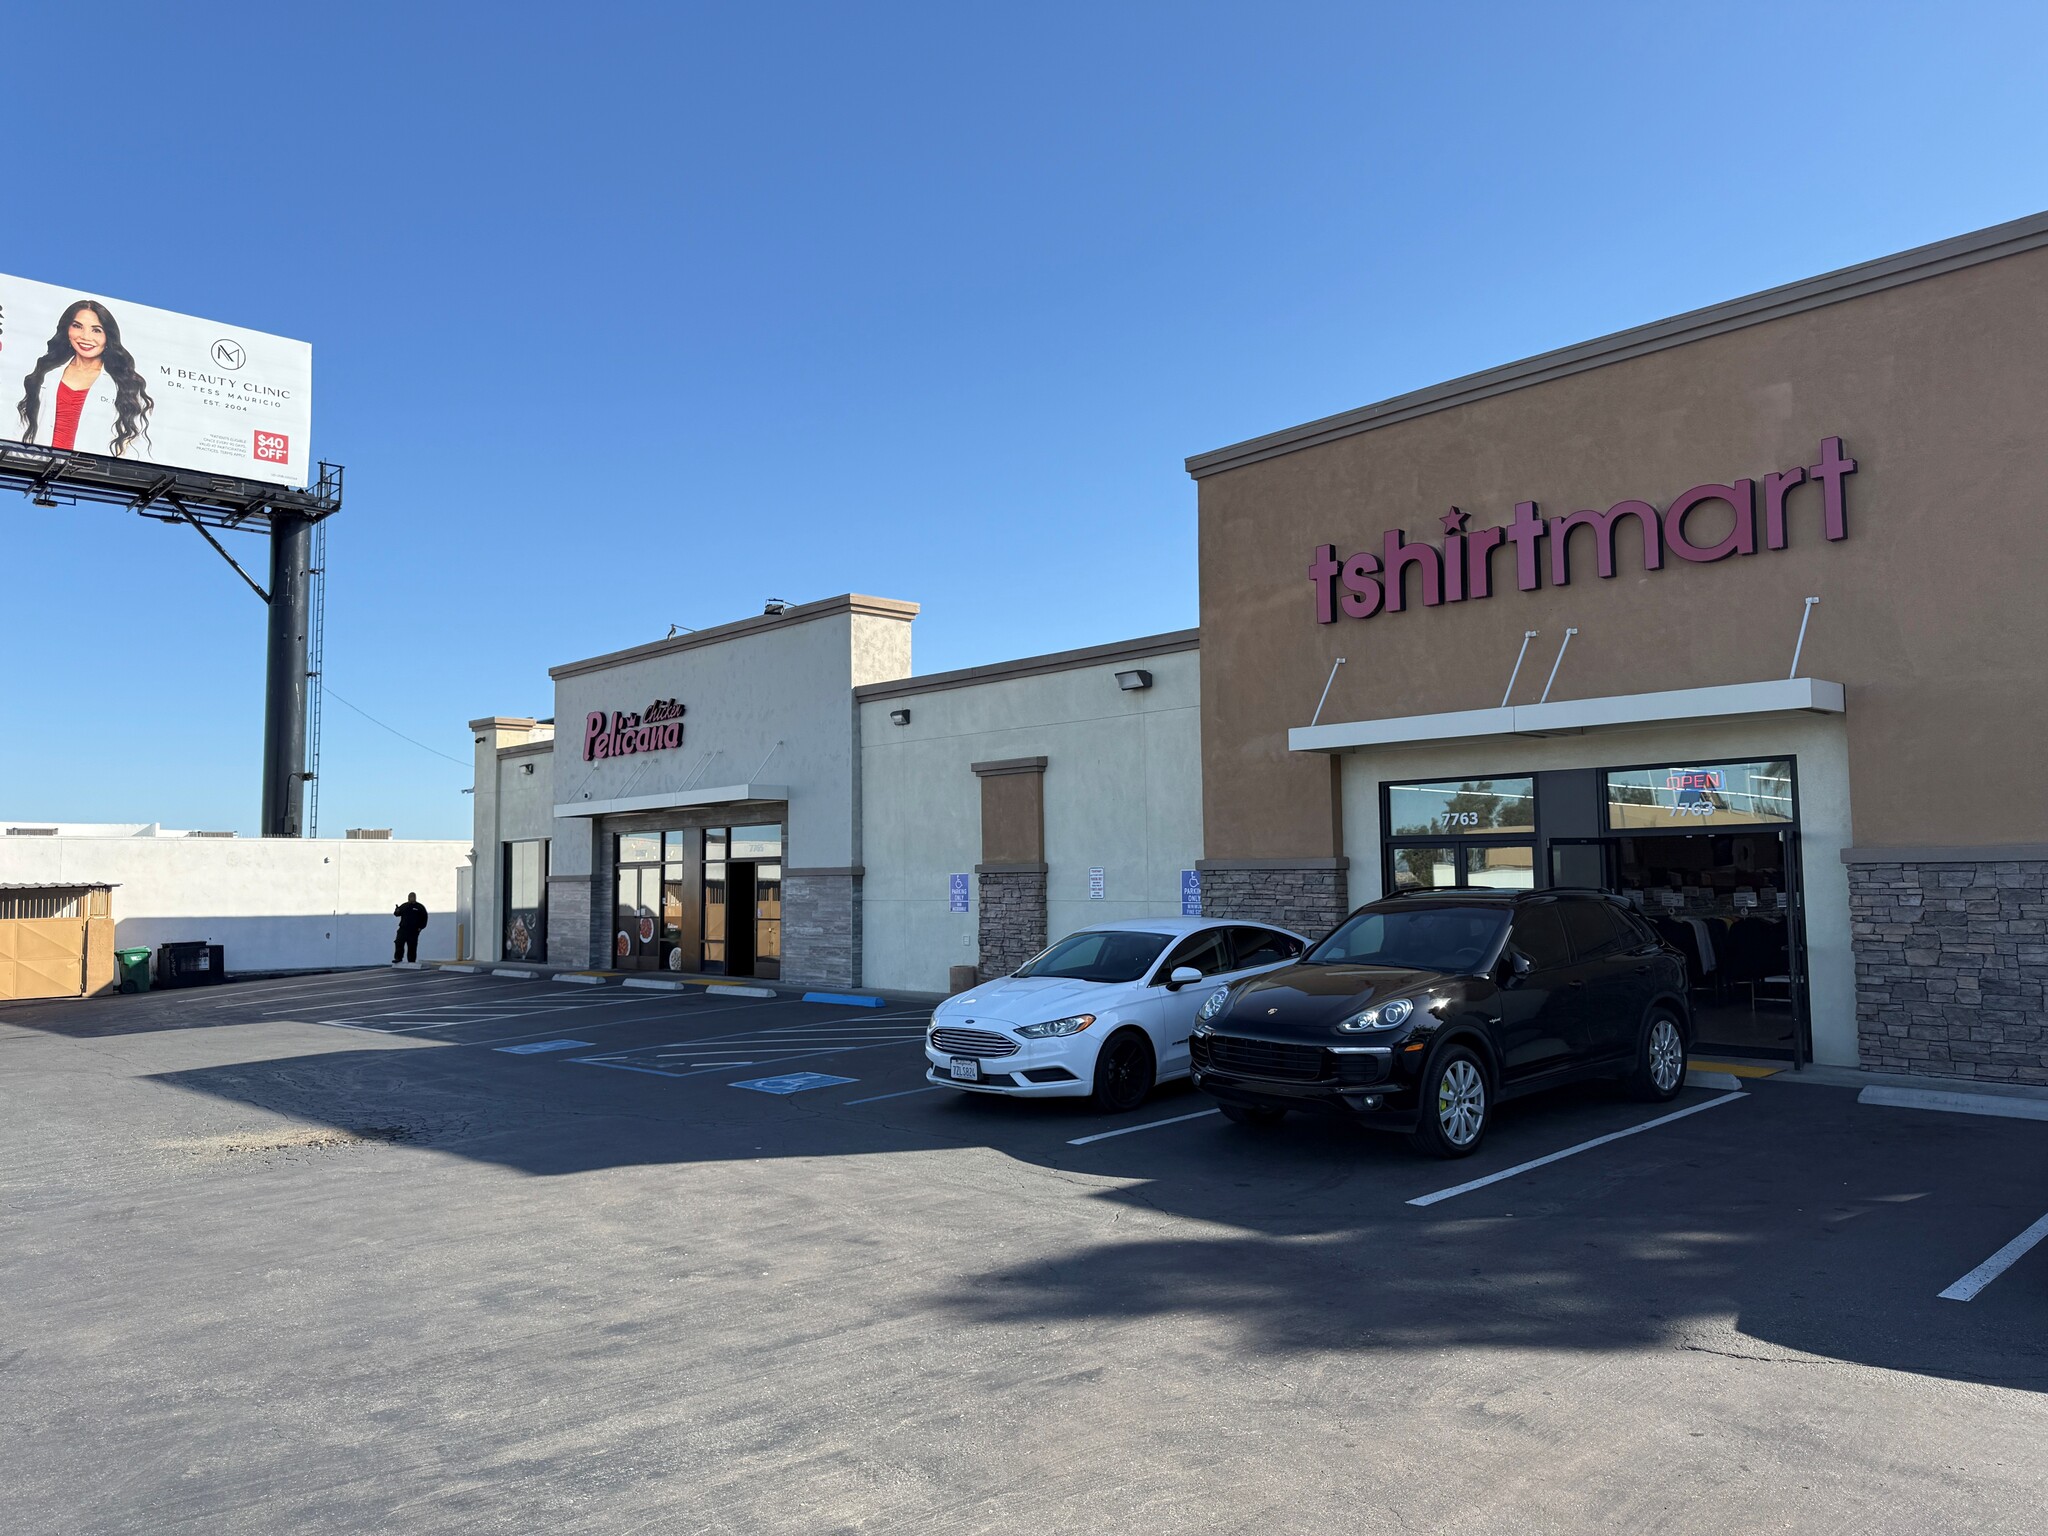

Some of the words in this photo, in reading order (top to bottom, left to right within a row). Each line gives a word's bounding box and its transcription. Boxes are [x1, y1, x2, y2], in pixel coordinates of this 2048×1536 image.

[160, 365, 171, 375] M
[178, 369, 237, 388] BEAUTY
[243, 382, 291, 399] CLINIC
[167, 380, 185, 389] DR.
[192, 385, 220, 396] TESS
[227, 393, 281, 408] MAURICIO
[203, 399, 220, 407] EST.
[225, 403, 247, 412] 2004
[257, 433, 284, 449] $40
[1309, 436, 1857, 624] tshirtmart
[643, 698, 685, 724] Chicken
[583, 711, 684, 761] Pelicana
[1666, 773, 1720, 791] OPEN
[1441, 812, 1479, 826] 7763
[1669, 801, 1715, 817] 7763
